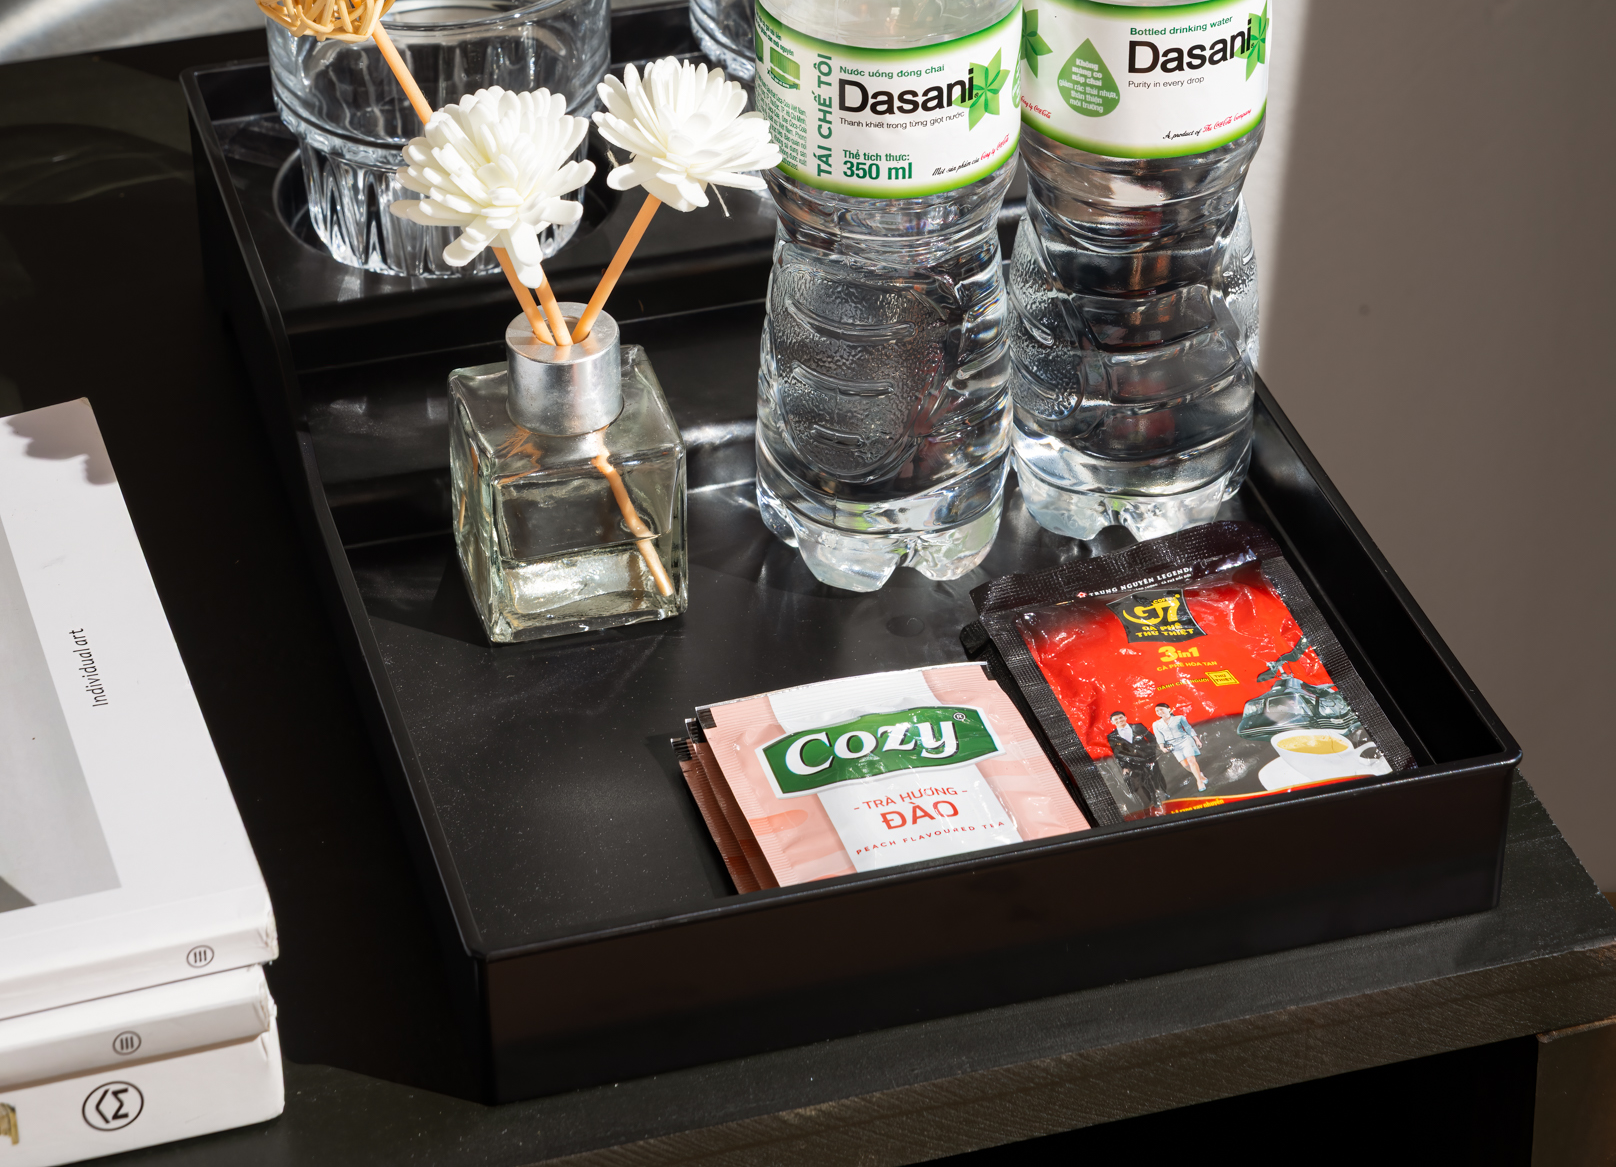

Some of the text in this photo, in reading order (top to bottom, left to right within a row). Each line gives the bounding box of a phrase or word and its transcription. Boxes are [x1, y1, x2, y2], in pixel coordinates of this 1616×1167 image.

[1130, 16, 1234, 36] Bottled drinking water
[1128, 18, 1253, 74] Dasani
[839, 65, 865, 77] Nước
[897, 68, 922, 78] đóng
[925, 64, 945, 74] chai
[838, 67, 974, 116] Dasani
[1086, 78, 1102, 86] chai
[1128, 76, 1205, 90] Purity in every drop
[811, 53, 833, 177] TÁI CHẾ TÔI
[839, 111, 965, 130] Thanh khiết trong từng giọt nước
[1162, 131, 1171, 139] A
[1194, 128, 1202, 137] of
[842, 149, 910, 164] Thể tích thực:
[843, 160, 913, 180] 350 ml
[1089, 587, 1118, 597] TRUNG
[1122, 597, 1180, 625] G7
[1158, 645, 1200, 662] 3in1
[69, 628, 109, 707] Individual art
[1156, 664, 1169, 672] CÀ
[785, 720, 960, 776] Cozy
[862, 787, 958, 809] TRÀ HƯƠNG
[880, 800, 959, 830] ĐÀO
[856, 821, 1005, 855] PEACH FLAVOURED TEA
